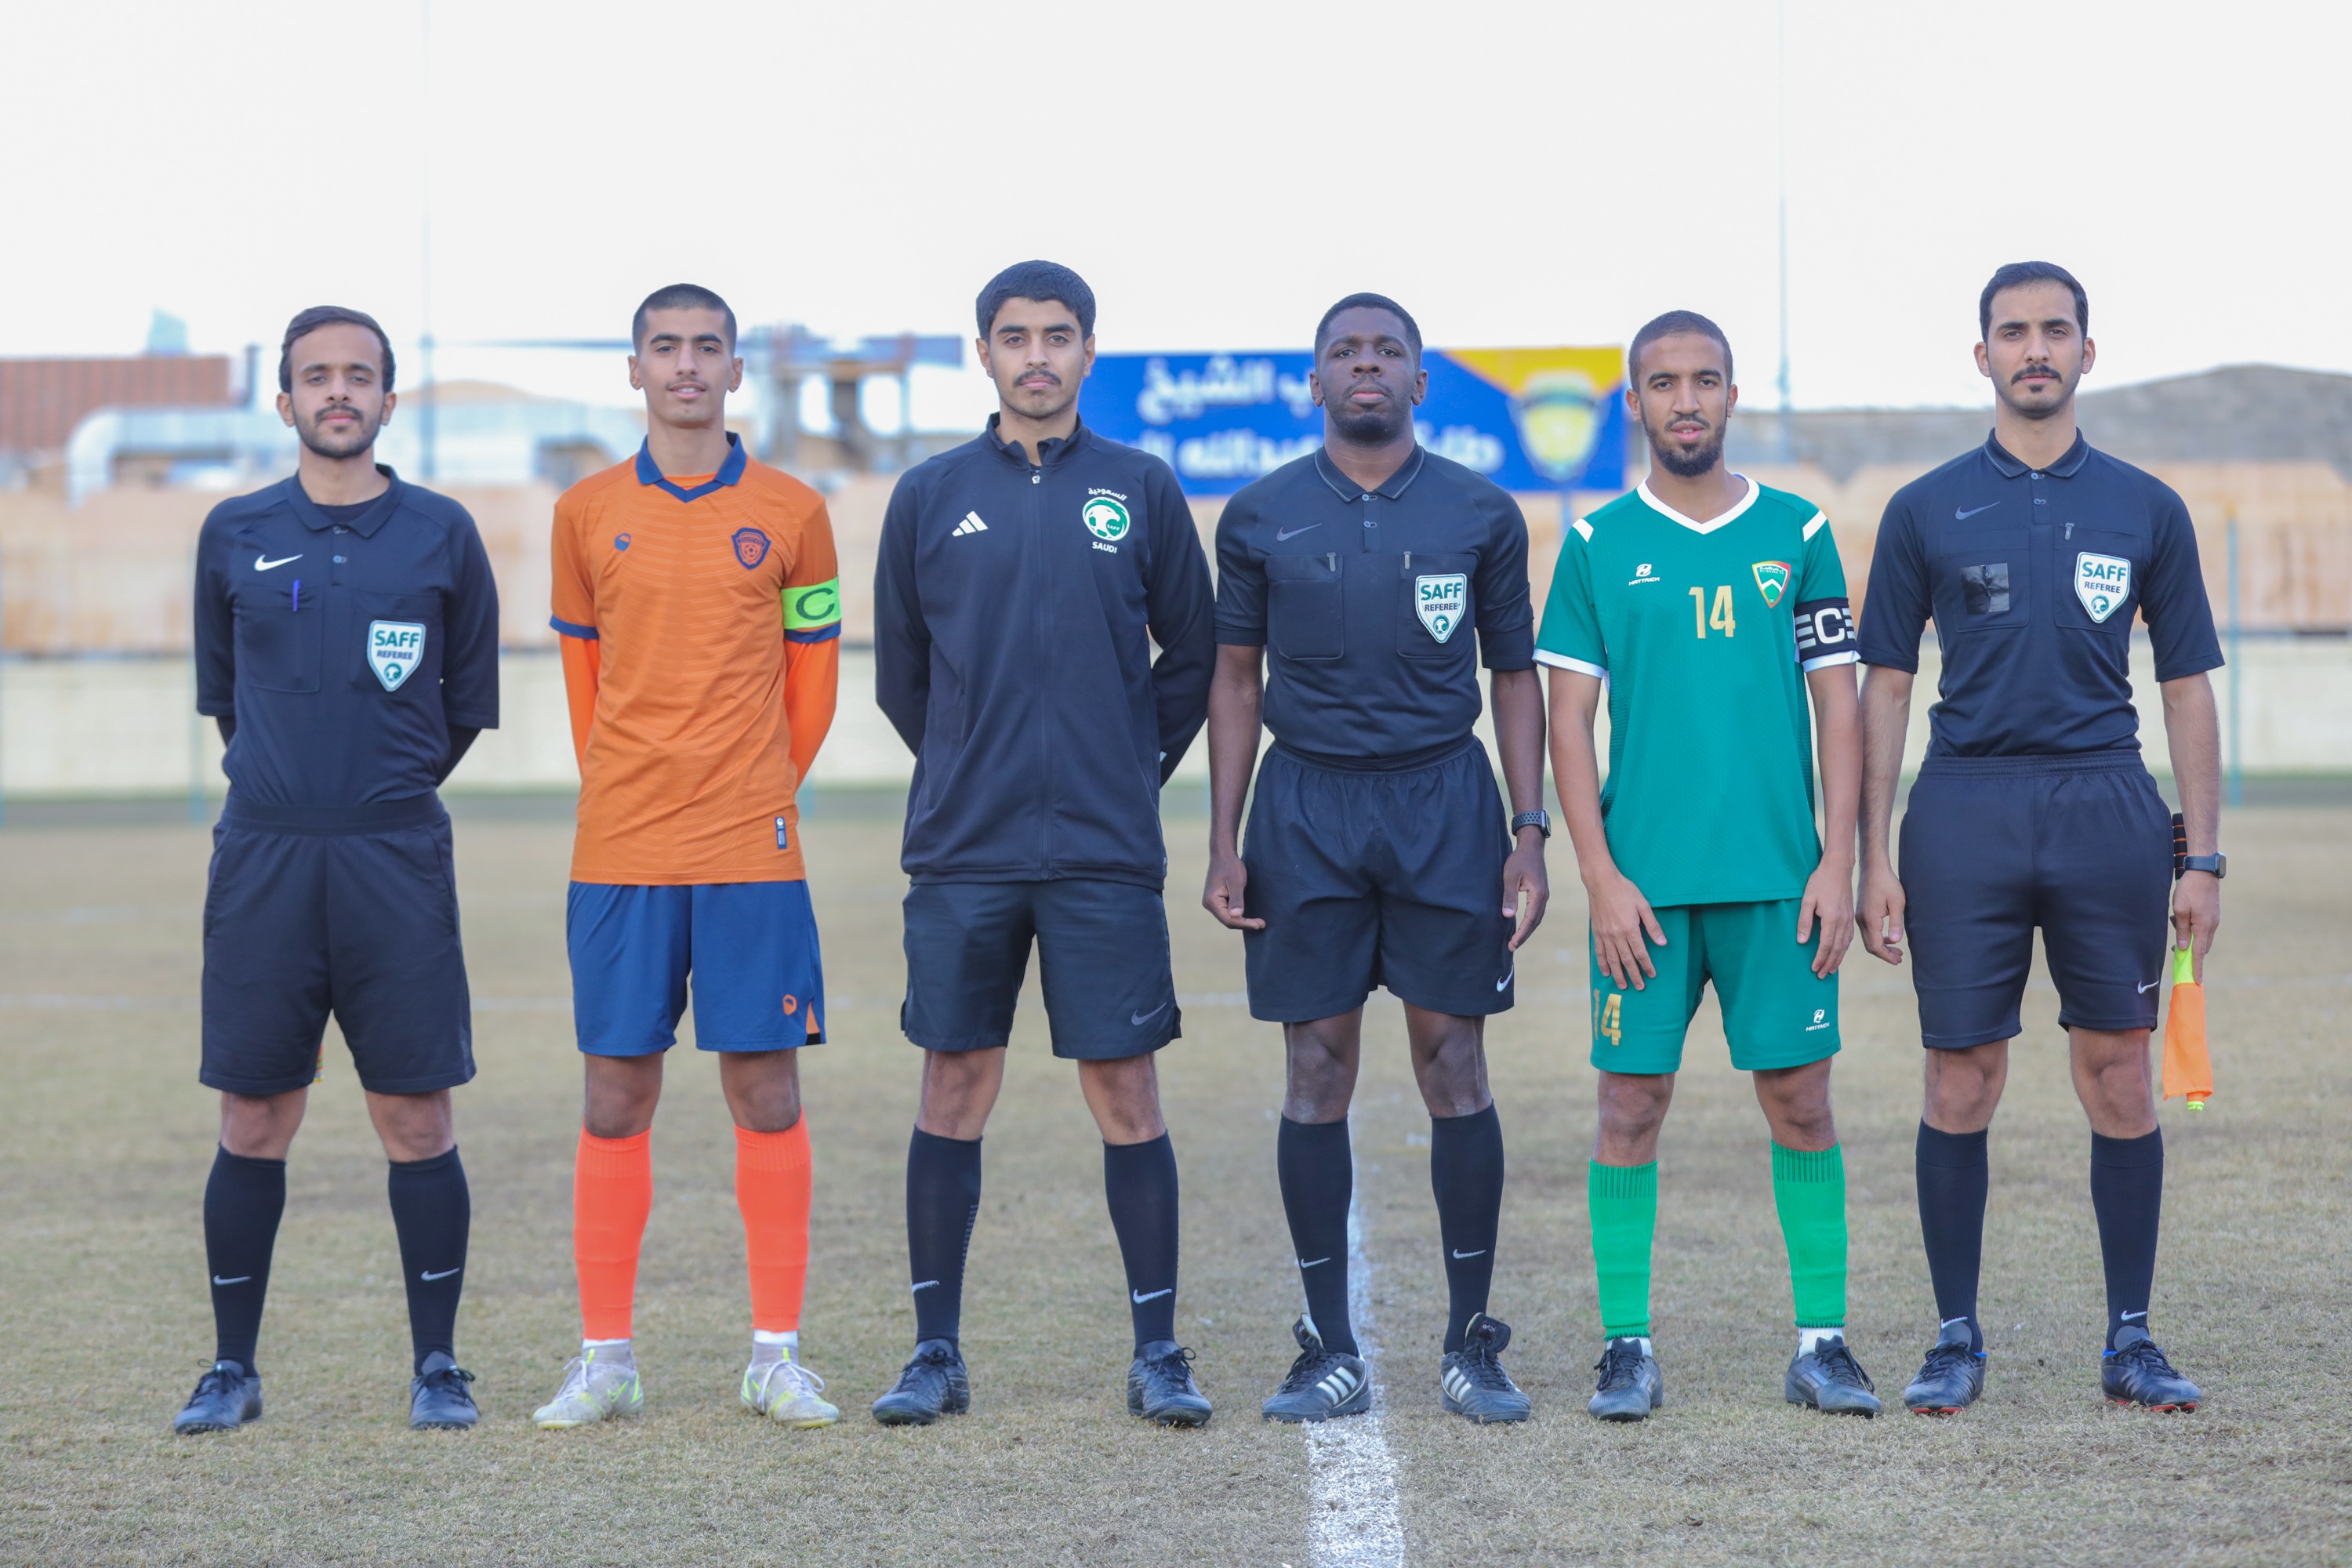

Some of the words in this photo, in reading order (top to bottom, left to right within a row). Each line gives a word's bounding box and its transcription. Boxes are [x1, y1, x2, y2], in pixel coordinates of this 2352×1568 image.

[1087, 488, 1127, 501] السعودية
[1092, 541, 1117, 554] SAUDI
[2082, 561, 2126, 582] SAFF
[1421, 583, 1462, 601] SAFF
[2084, 581, 2122, 593] REFEREE
[795, 587, 835, 620] C
[1425, 603, 1458, 612] REFEREE
[1688, 585, 1736, 638] 14
[1815, 608, 1846, 644] C
[375, 630, 420, 648] SAFF
[376, 650, 414, 660] REFEREE
